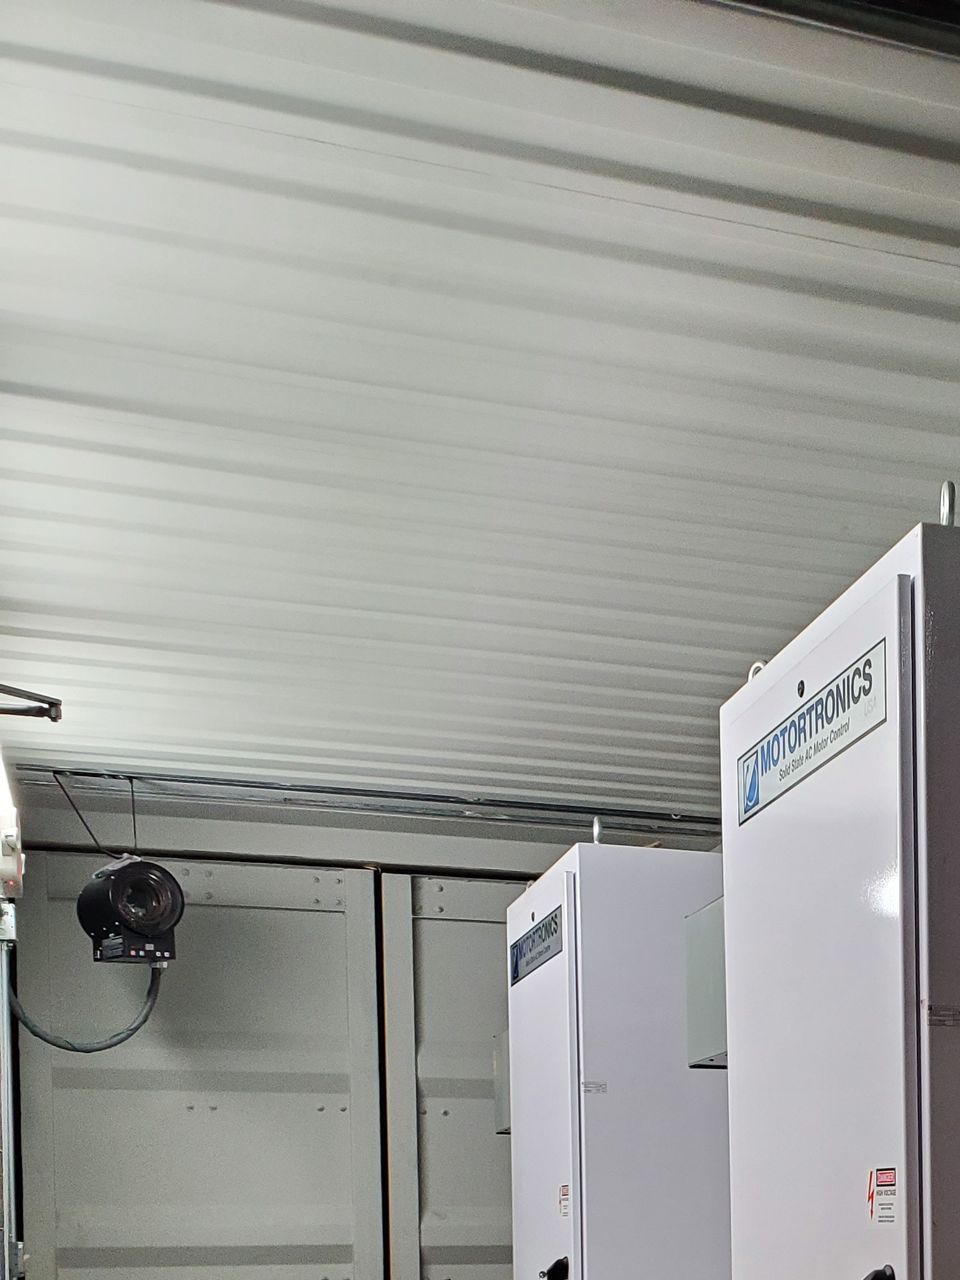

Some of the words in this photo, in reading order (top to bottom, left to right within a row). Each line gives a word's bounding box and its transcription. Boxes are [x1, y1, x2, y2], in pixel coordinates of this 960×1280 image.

[761, 658, 873, 776] MOTORTRONICS
[779, 762, 791, 781] Solid
[791, 755, 804, 772] State
[804, 746, 813, 763] AC
[813, 736, 829, 756] Motor
[829, 717, 850, 744] Control
